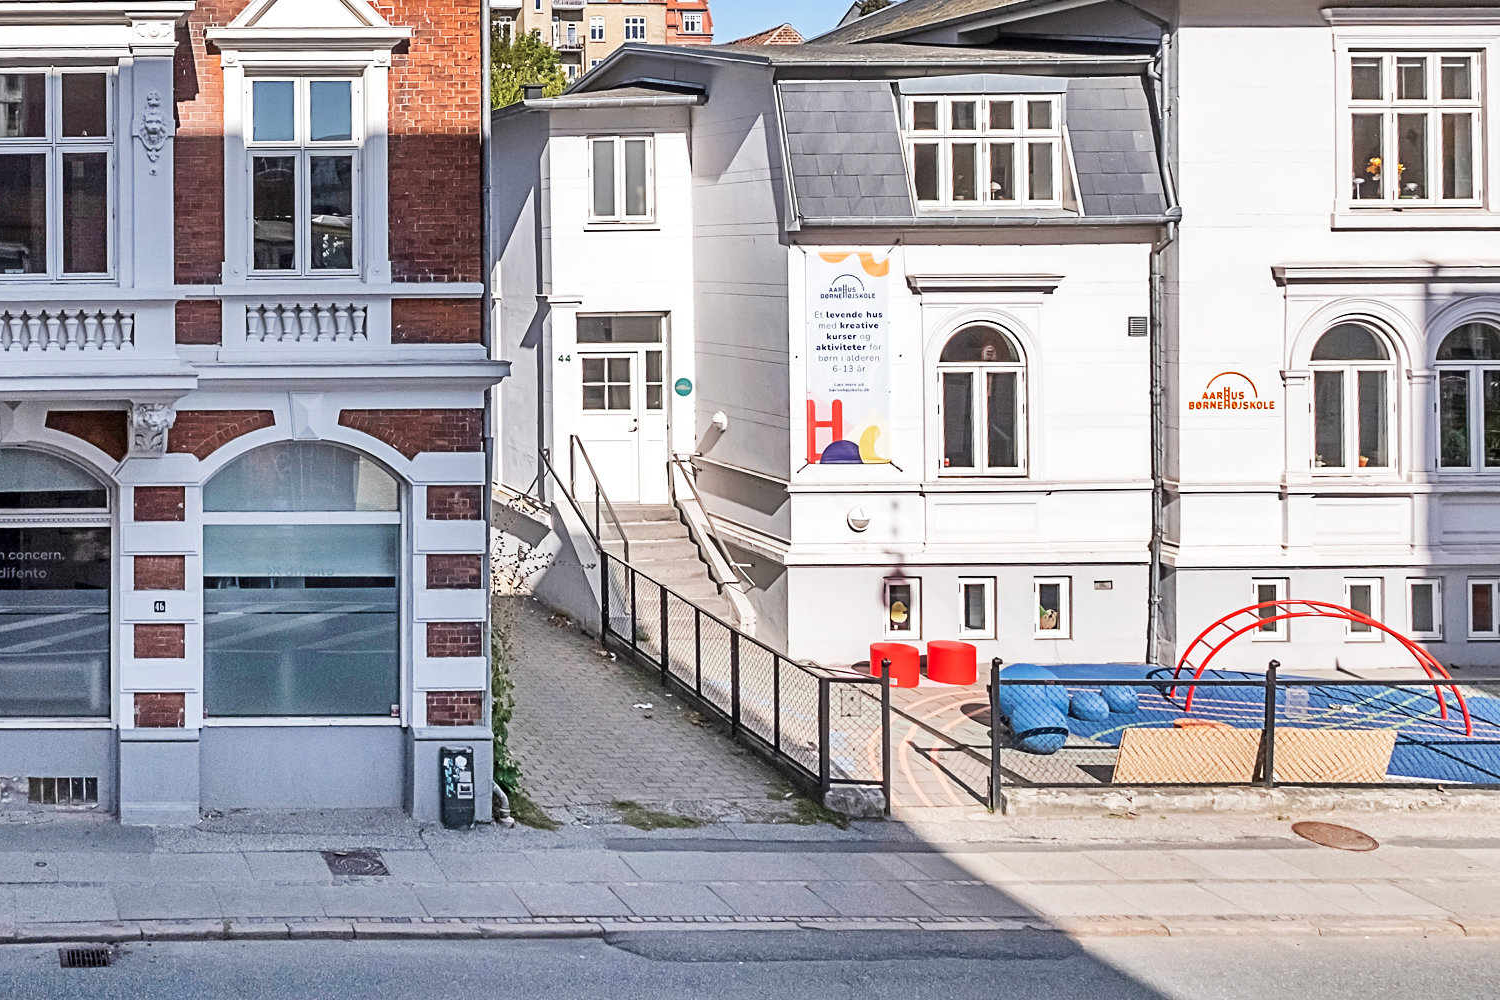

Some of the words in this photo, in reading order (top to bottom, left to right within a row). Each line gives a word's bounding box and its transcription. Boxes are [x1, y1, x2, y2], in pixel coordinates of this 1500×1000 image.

[829, 285, 856, 293] AARHUS
[814, 310, 824, 319] Et
[826, 310, 863, 319] levende
[866, 310, 883, 319] hus
[840, 321, 879, 329] kreative
[826, 332, 857, 340] kurser
[815, 343, 866, 351] aktiviteter
[869, 343, 882, 351] for
[557, 354, 572, 363] 44
[818, 354, 838, 362] børn
[846, 354, 880, 362] alderen
[832, 364, 854, 373] 6-13
[856, 364, 866, 373] år
[1202, 387, 1245, 400] AARHUS
[1188, 400, 1275, 410] BØRNEHØJSKOLE
[8, 551, 65, 561] concern.
[154, 602, 165, 612] 46
